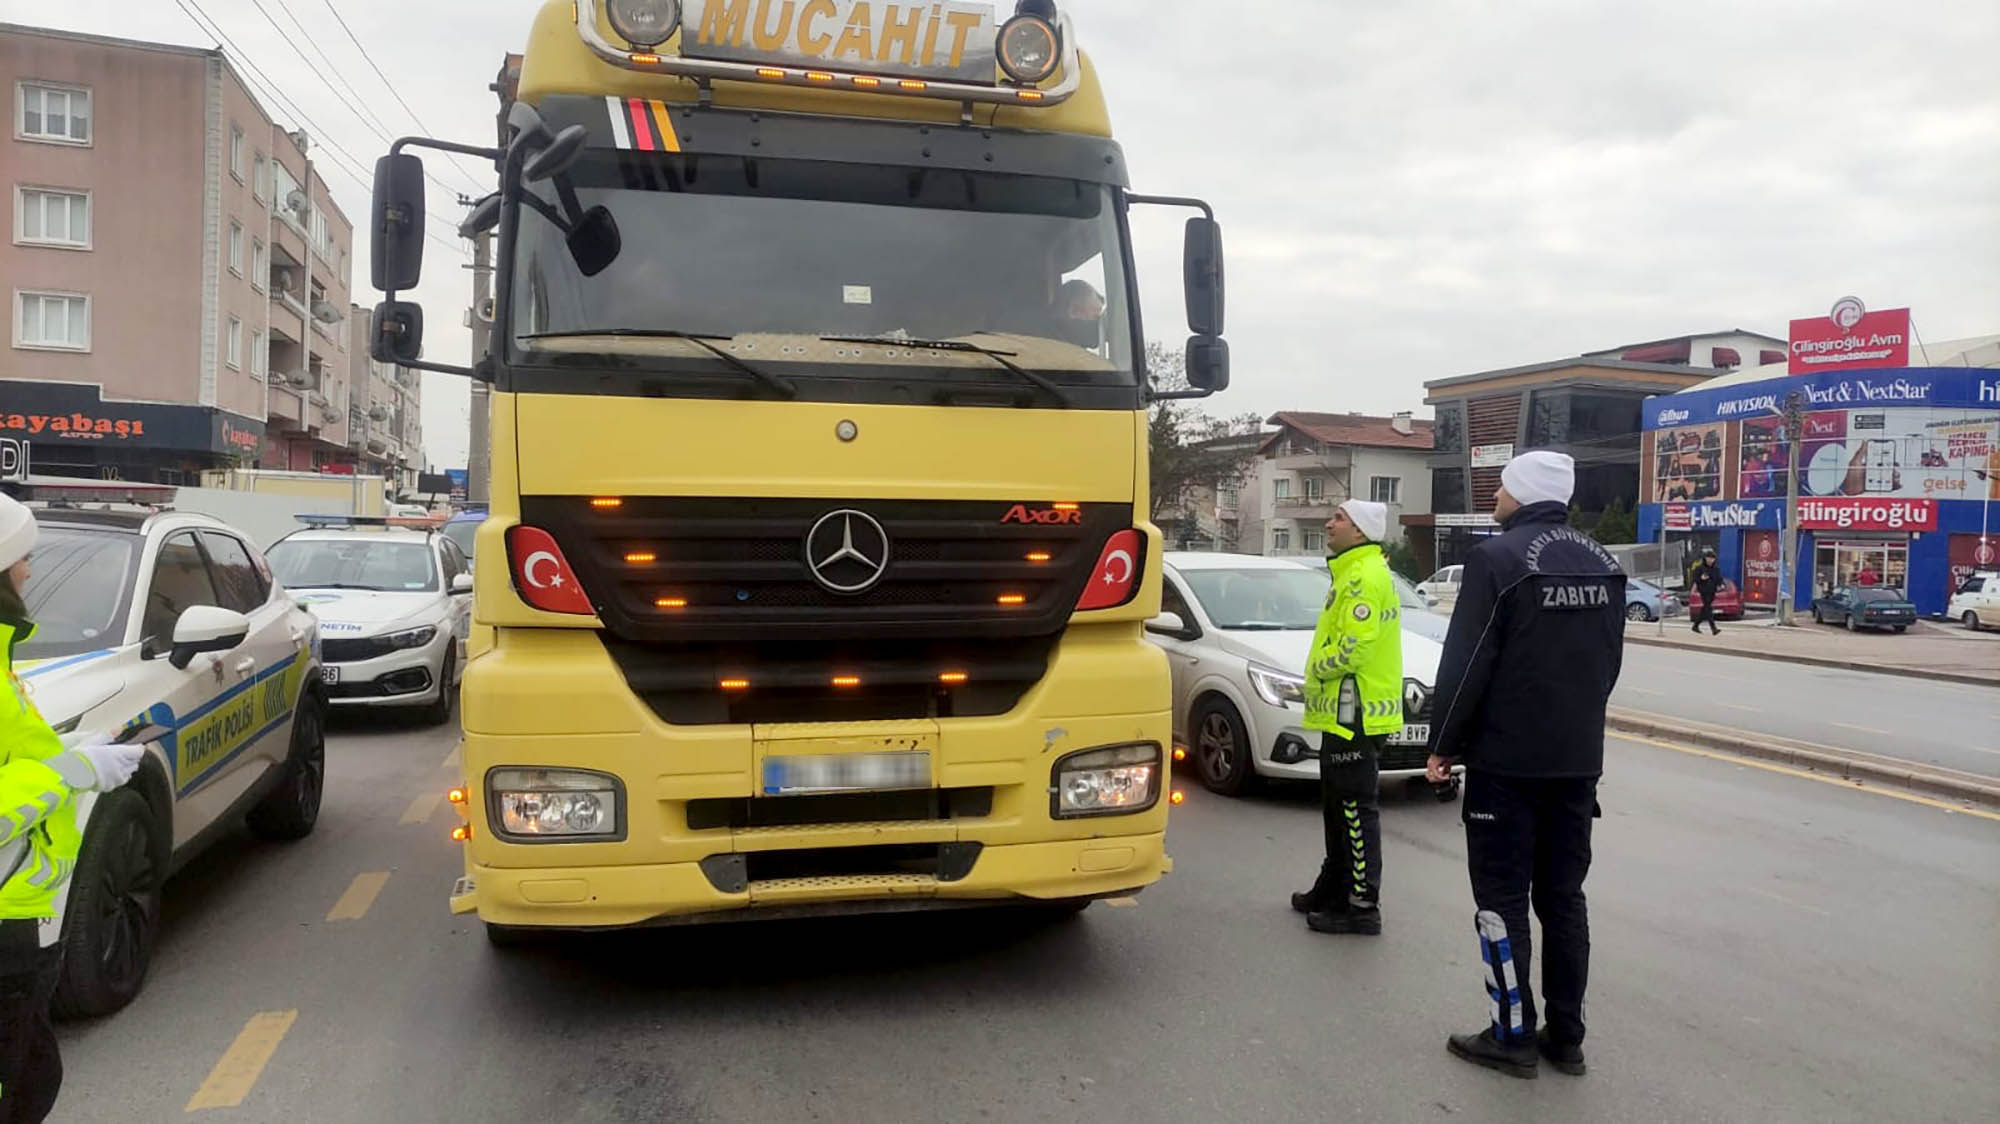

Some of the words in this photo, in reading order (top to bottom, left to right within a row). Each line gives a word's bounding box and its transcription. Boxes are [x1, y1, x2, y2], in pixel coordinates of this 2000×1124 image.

[1868, 333, 1902, 346] Avm
[1804, 384, 1834, 403] Next
[1837, 382, 1852, 402] &
[1857, 379, 1928, 401] NextStar
[1717, 395, 1776, 415] HIKVISION
[1690, 503, 1758, 527] t-NextStar
[1542, 585, 1609, 607] ZABITA
[185, 715, 222, 769] TRAFİK
[1407, 726, 1428, 741] BVR
